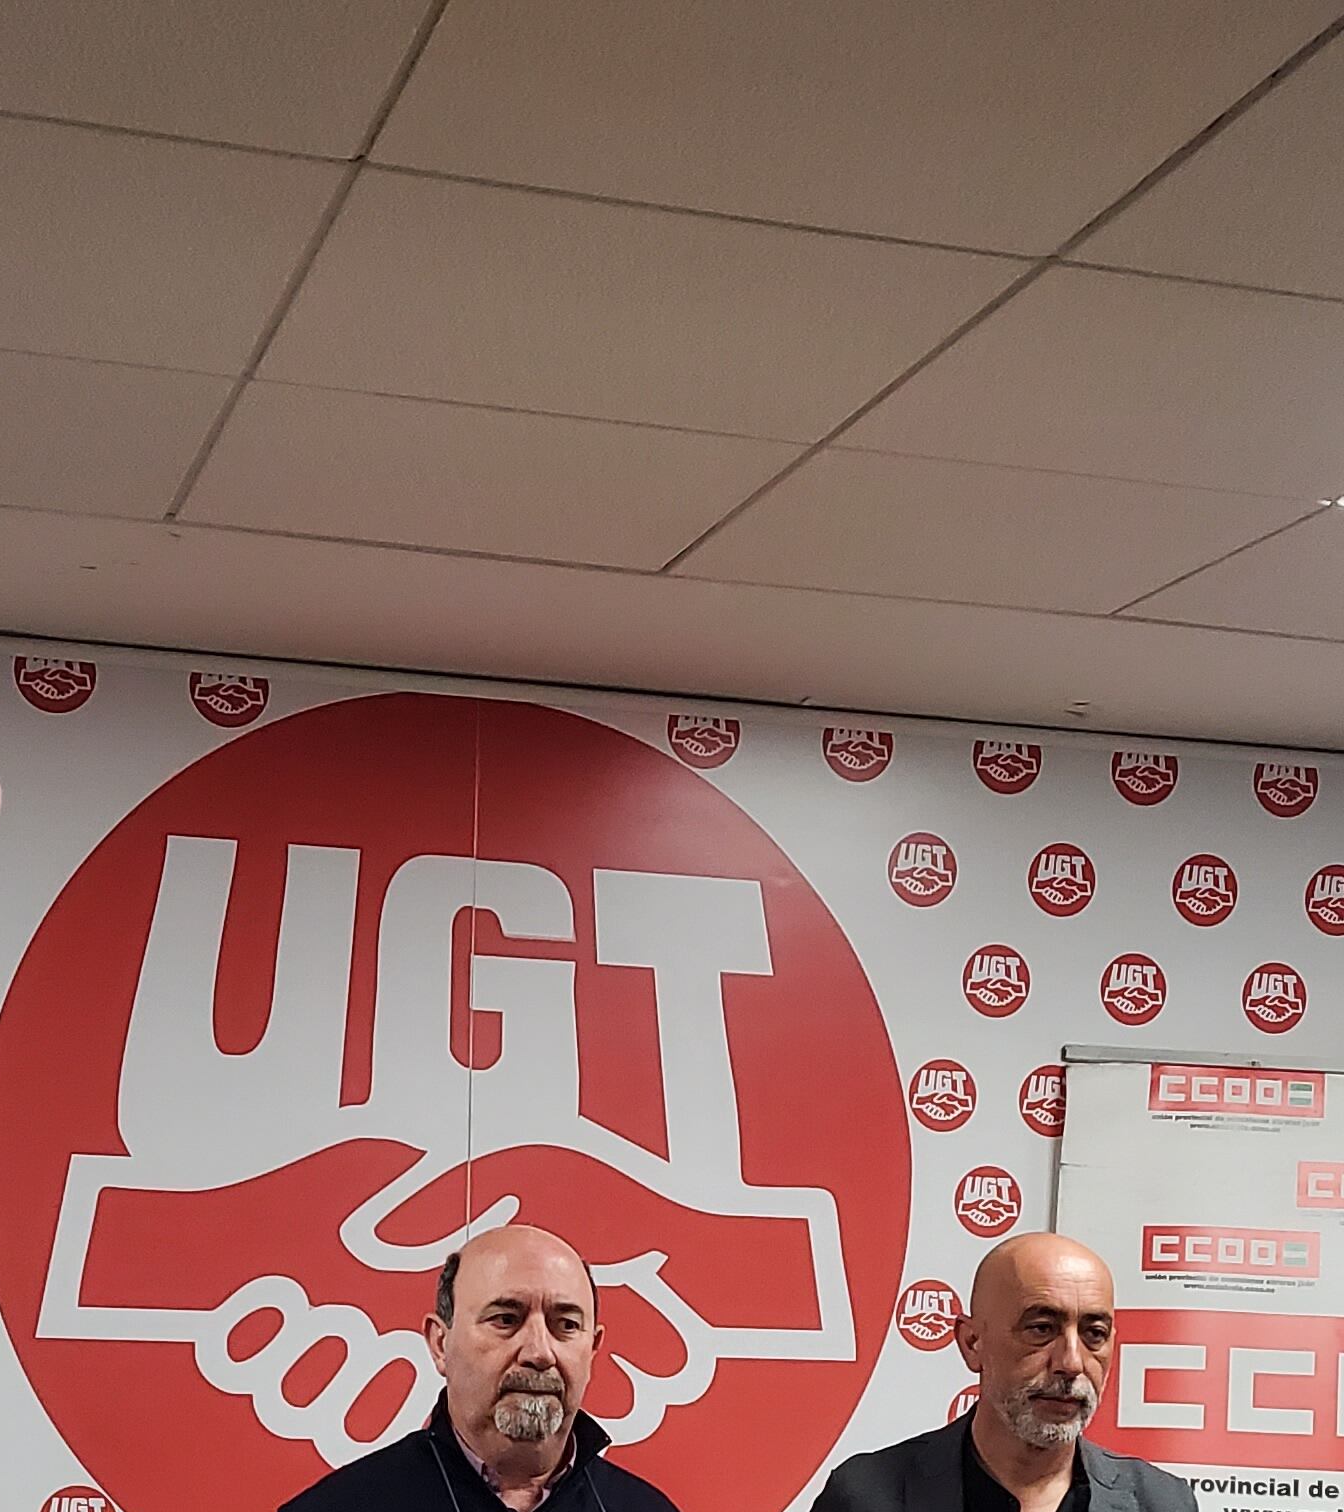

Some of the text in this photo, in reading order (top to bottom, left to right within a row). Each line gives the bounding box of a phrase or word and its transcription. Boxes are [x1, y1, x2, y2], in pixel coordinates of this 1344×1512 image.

[898, 842, 951, 870] UGT
[1038, 853, 1087, 880] UGT
[973, 953, 1022, 981] UGT
[1111, 962, 1159, 989] UGT
[1252, 972, 1299, 998] UGT
[116, 834, 774, 1185] UGT
[1158, 1073, 1284, 1108] CCOO
[1151, 1234, 1277, 1267] CCOO
[1189, 1475, 1300, 1497] rovincial
[1308, 1481, 1340, 1500] de
